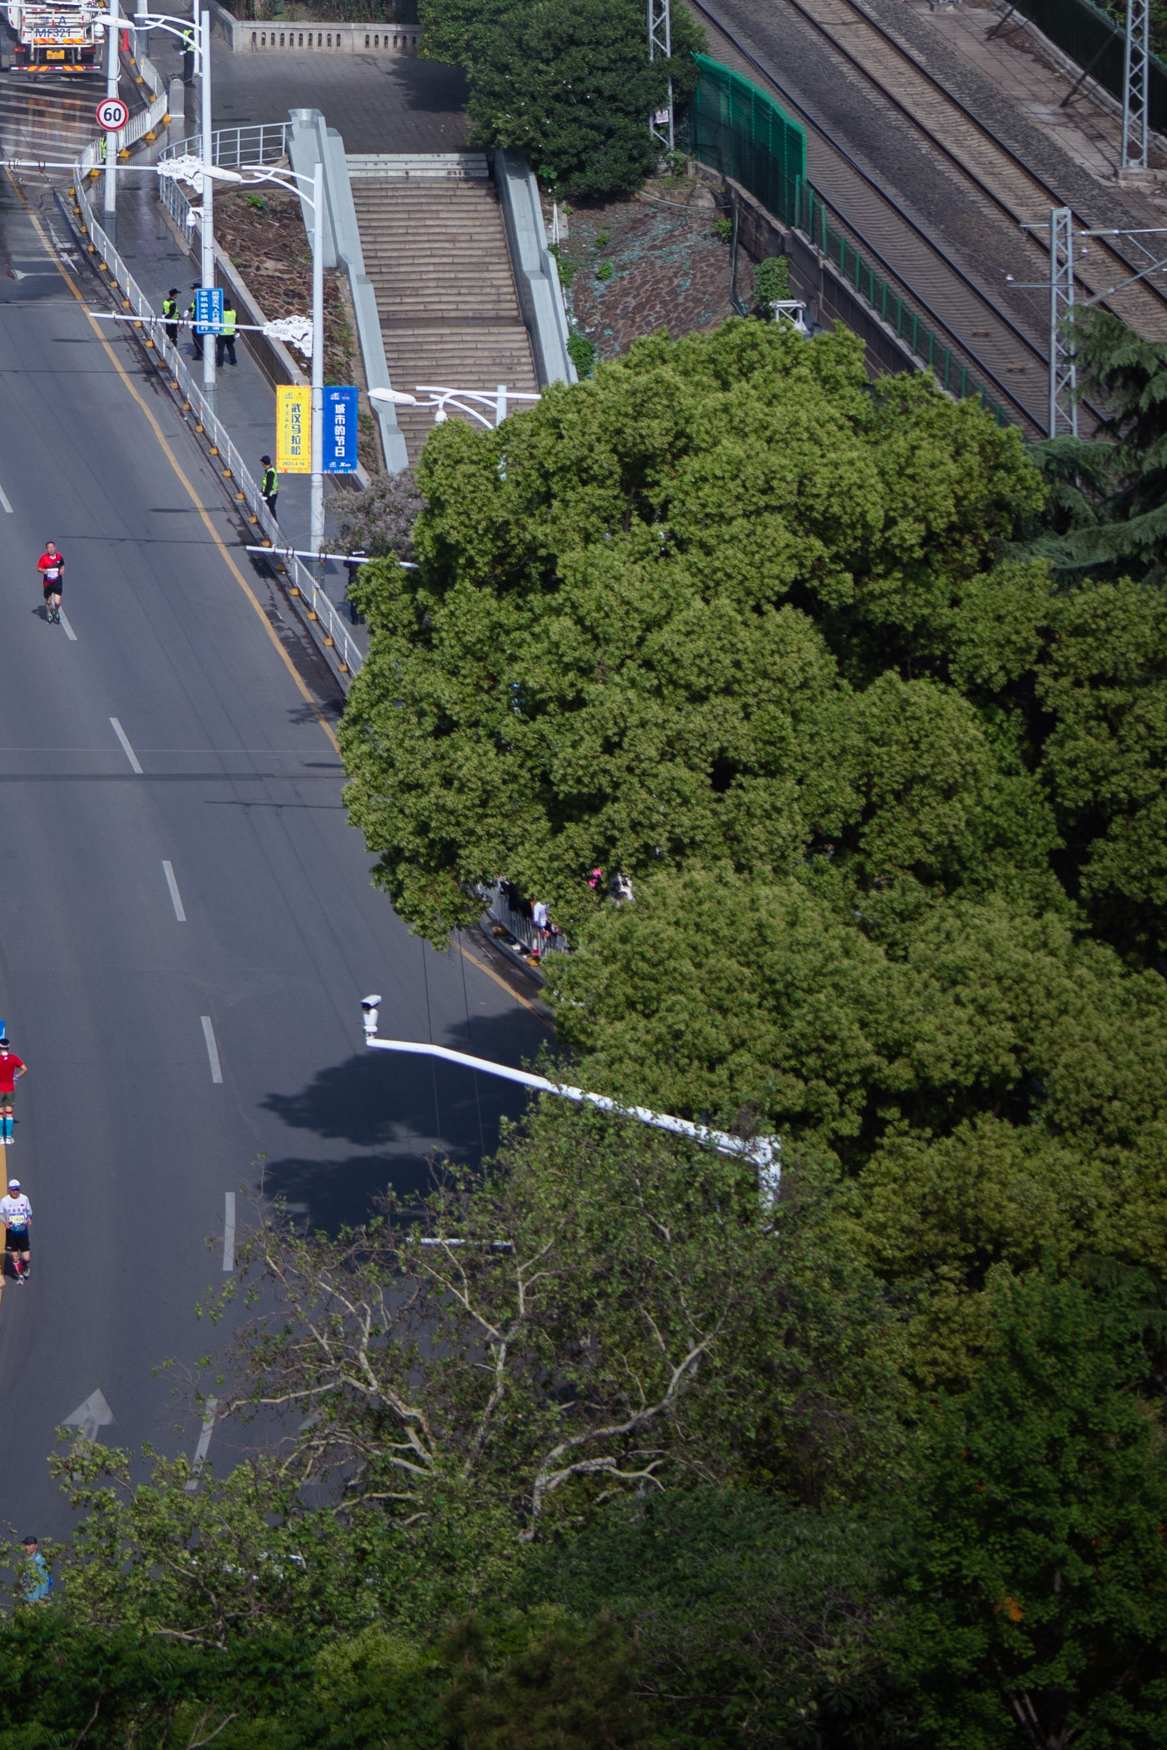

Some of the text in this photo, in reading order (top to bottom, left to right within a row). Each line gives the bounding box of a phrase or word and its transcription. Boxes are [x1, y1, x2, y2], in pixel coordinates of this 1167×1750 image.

[35, 28, 71, 38] MF321
[103, 107, 122, 122] 60
[291, 403, 302, 456] 武汉马拉松
[335, 403, 346, 457] 城市的节日
